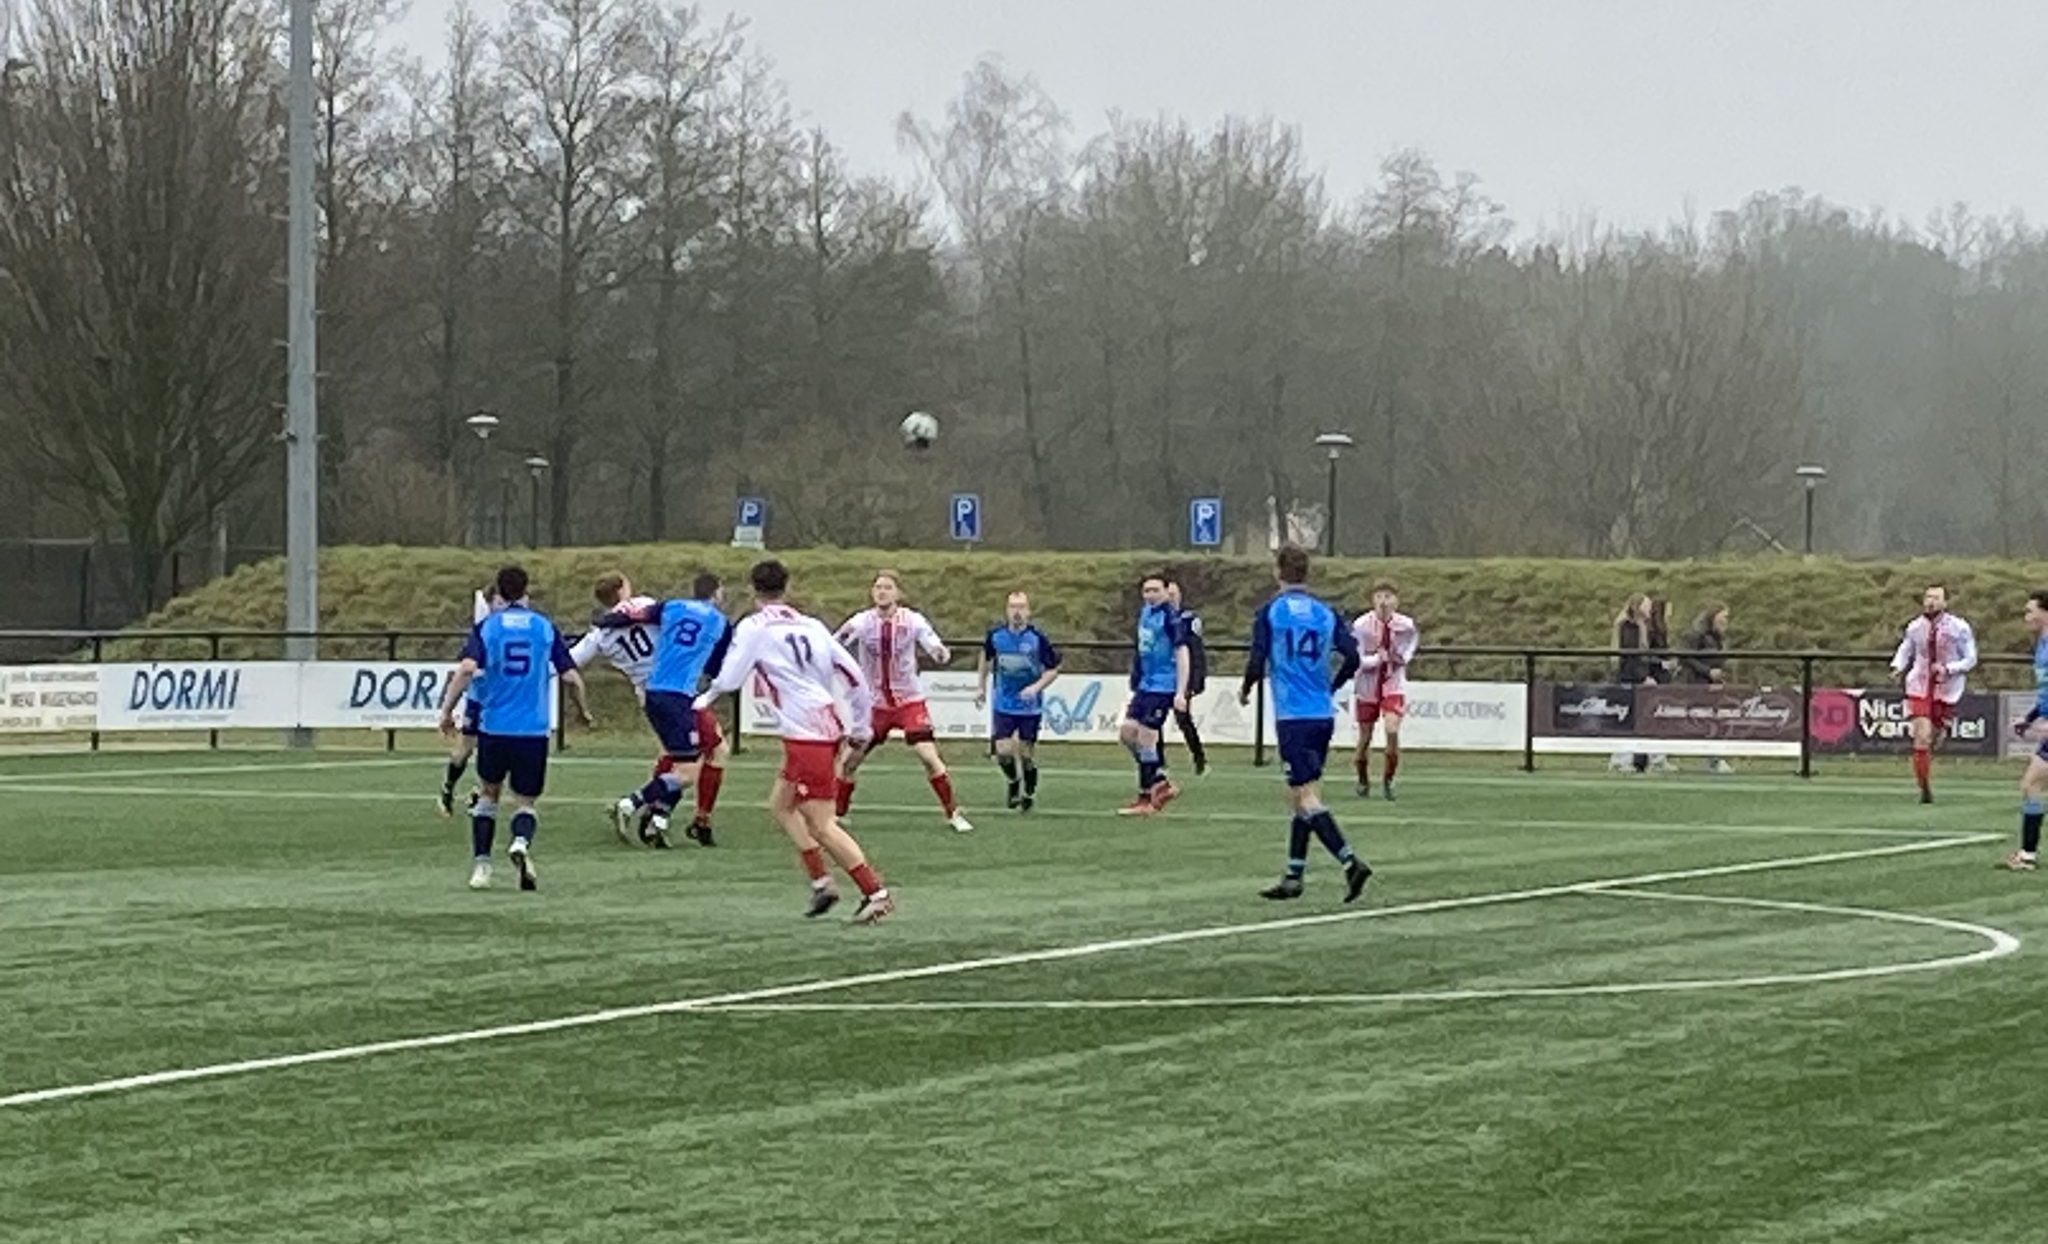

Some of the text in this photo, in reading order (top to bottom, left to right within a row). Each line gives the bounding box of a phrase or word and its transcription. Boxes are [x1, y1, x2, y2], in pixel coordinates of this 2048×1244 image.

[743, 502, 758, 524] P
[957, 499, 973, 522] P
[1196, 503, 1215, 527] P
[616, 624, 654, 662] 10
[674, 617, 702, 647] 8
[1284, 628, 1321, 664] 14
[499, 641, 531, 676] 5
[350, 668, 455, 709] DOR
